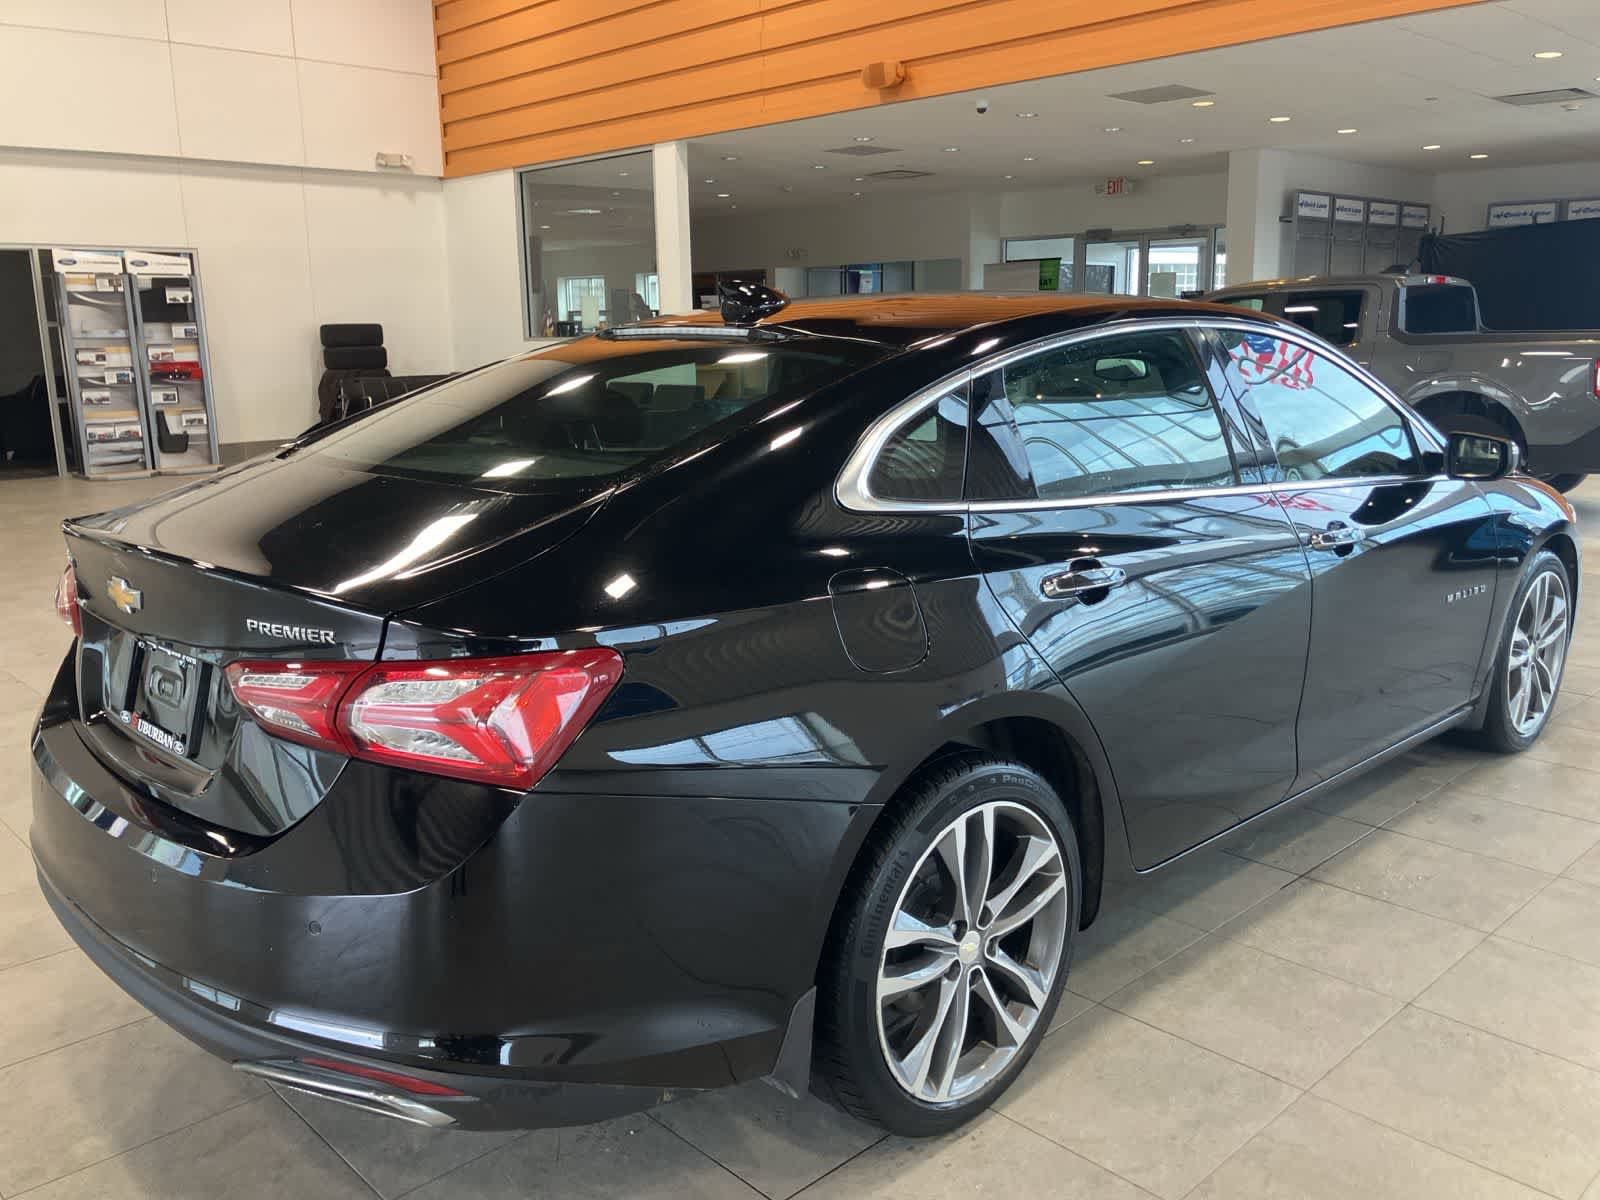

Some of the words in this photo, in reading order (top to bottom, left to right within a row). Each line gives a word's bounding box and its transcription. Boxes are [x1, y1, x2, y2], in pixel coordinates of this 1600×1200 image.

[1107, 178, 1125, 195] EXIT
[246, 618, 335, 644] PREMIER
[131, 711, 174, 749] SUBURBAN
